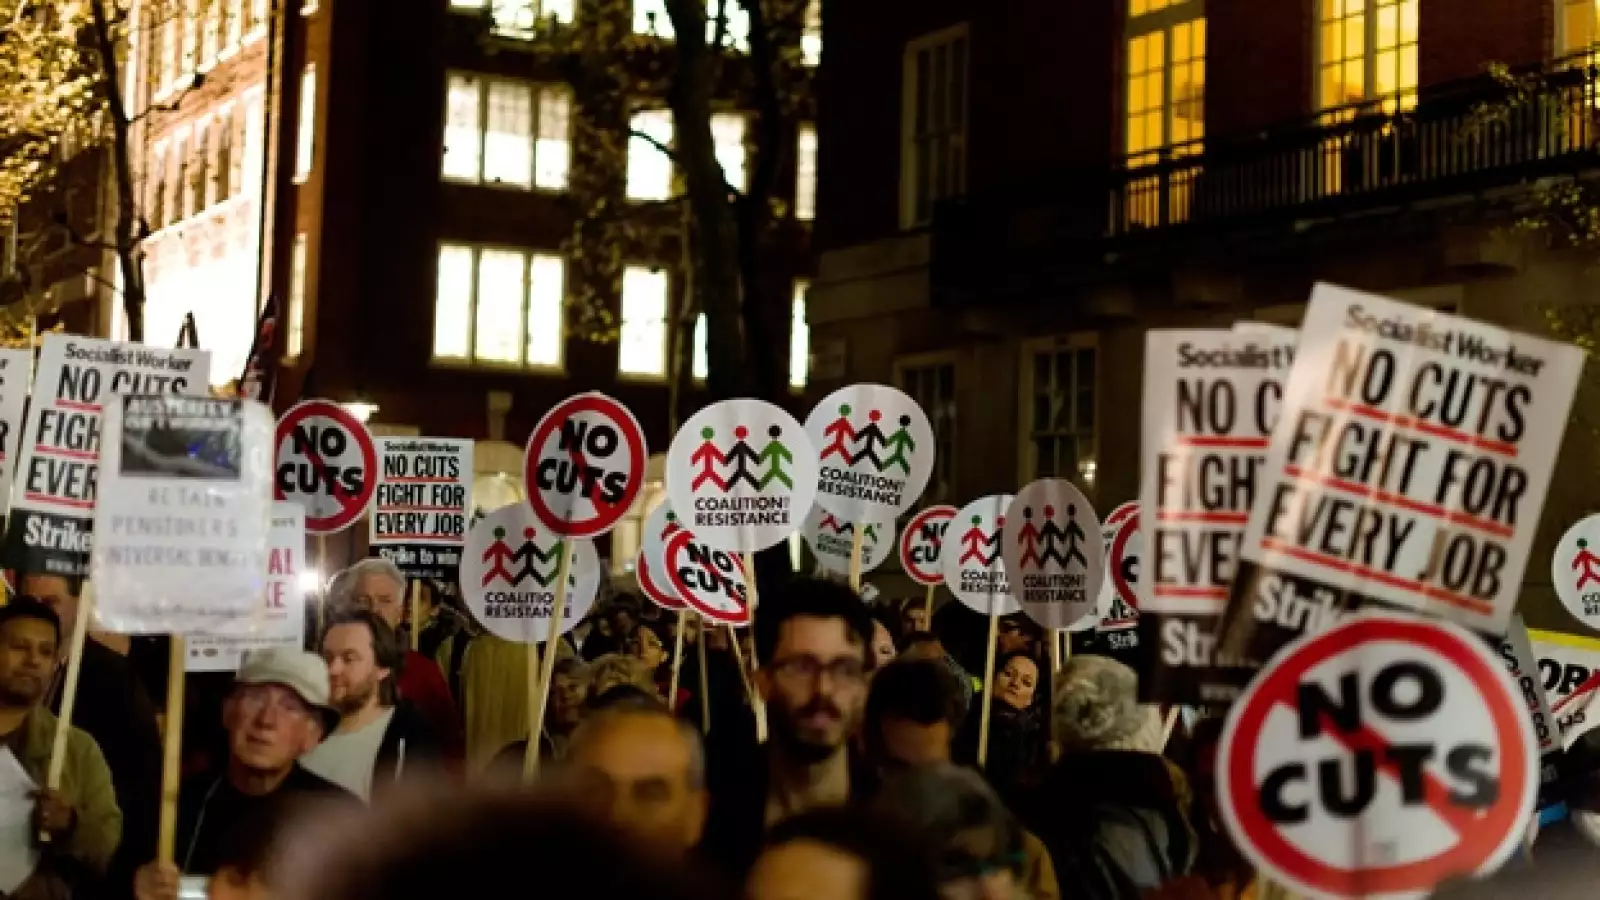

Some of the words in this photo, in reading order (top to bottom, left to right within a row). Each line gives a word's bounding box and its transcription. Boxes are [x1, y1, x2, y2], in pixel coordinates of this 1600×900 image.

[65, 342, 134, 365] Socialist
[135, 350, 193, 370] Worker
[1176, 342, 1282, 369] Socialist
[1345, 304, 1455, 350] Socialist
[1457, 332, 1545, 376] Worker
[57, 363, 101, 403] NO
[1327, 339, 1396, 406] NO
[1408, 360, 1532, 443] CUTS
[1176, 376, 1236, 435] NO
[36, 408, 100, 450] FIGH
[292, 423, 347, 457] NO
[559, 418, 619, 459] NO
[26, 455, 98, 499] EVER
[277, 460, 364, 497] CUTS
[384, 453, 408, 477] NO
[413, 453, 460, 477] CUTS
[535, 457, 627, 504] CUTS
[820, 466, 898, 493] COALITION
[1288, 409, 1429, 495] FIGHT
[1436, 449, 1527, 525] FOR
[376, 484, 427, 506] FIGHT
[430, 484, 465, 506] FOR
[694, 497, 783, 510] COALITION
[817, 480, 901, 506] RESISTANCE
[376, 512, 429, 534] EVERY
[431, 512, 465, 534] JOB
[694, 511, 791, 526] RESISTANCE
[687, 543, 733, 572] NO
[911, 545, 941, 563] CU
[1155, 528, 1244, 587] EVE
[1264, 482, 1416, 571] EVERY
[1417, 526, 1507, 600] JOB
[484, 591, 556, 604] COALITIO
[1023, 574, 1080, 588] COALITION
[484, 604, 572, 618] RESISTANE
[1297, 661, 1446, 739] NO
[1259, 742, 1500, 825] CUTS
